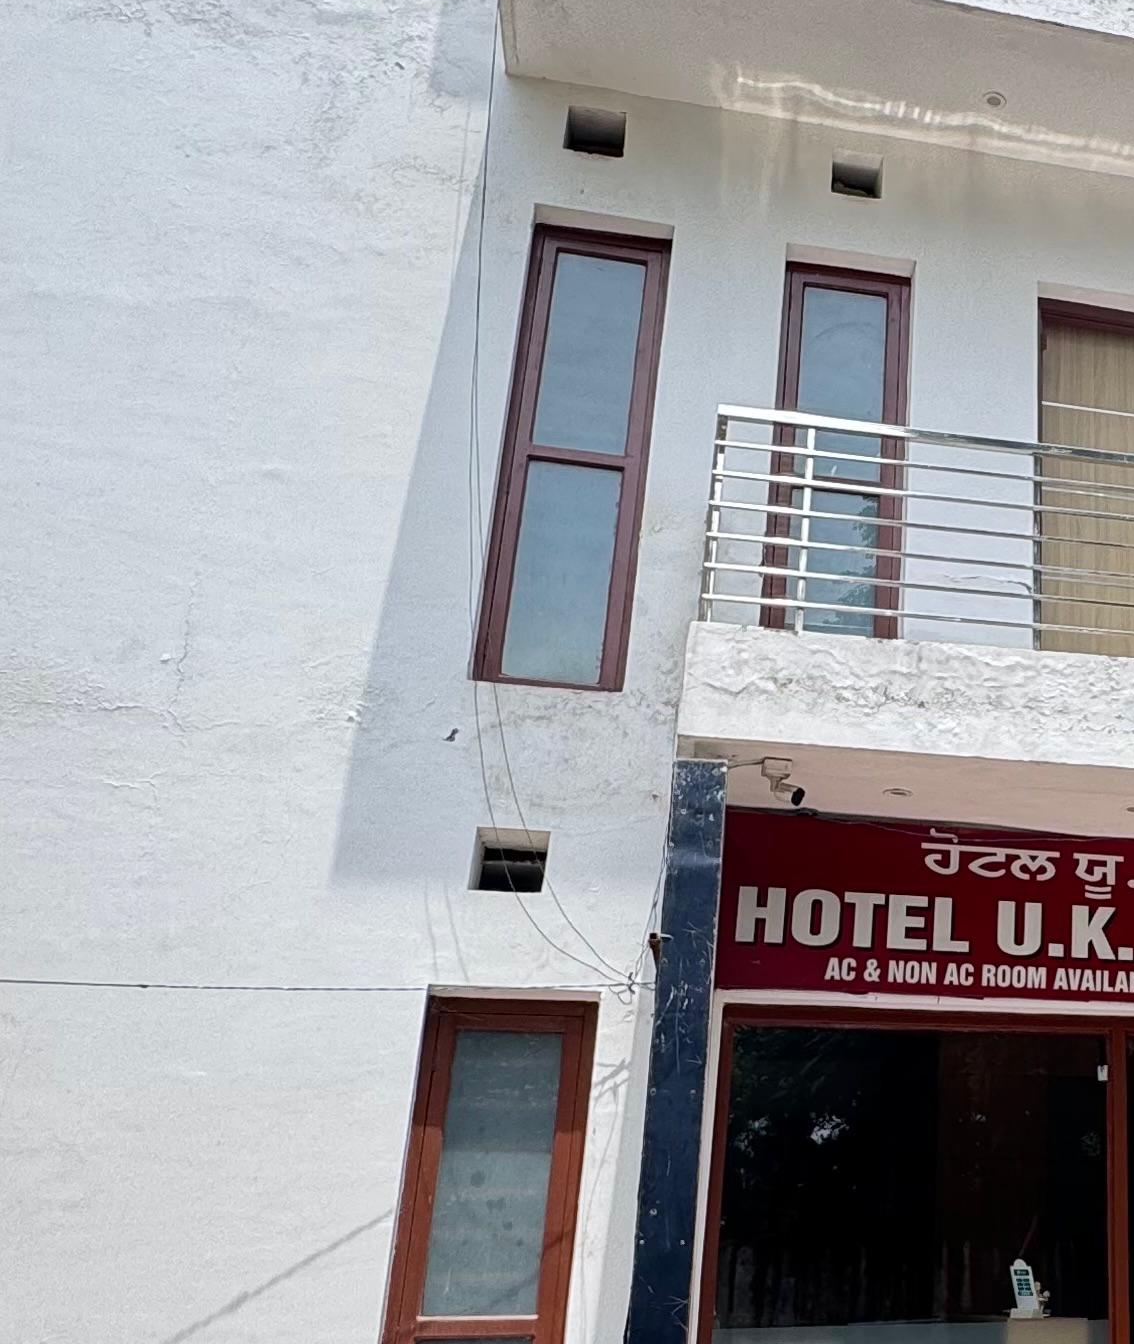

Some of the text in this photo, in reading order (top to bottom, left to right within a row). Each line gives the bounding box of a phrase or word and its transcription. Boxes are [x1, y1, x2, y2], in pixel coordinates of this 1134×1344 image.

[920, 827, 1061, 881] ਹੋਟਲ
[734, 885, 970, 954] HOTEL
[996, 899, 1134, 962] U.K.
[824, 957, 857, 982] AC
[863, 958, 882, 983] &
[887, 959, 938, 986] NON
[943, 962, 975, 987] AC
[981, 964, 1048, 990] ROOM
